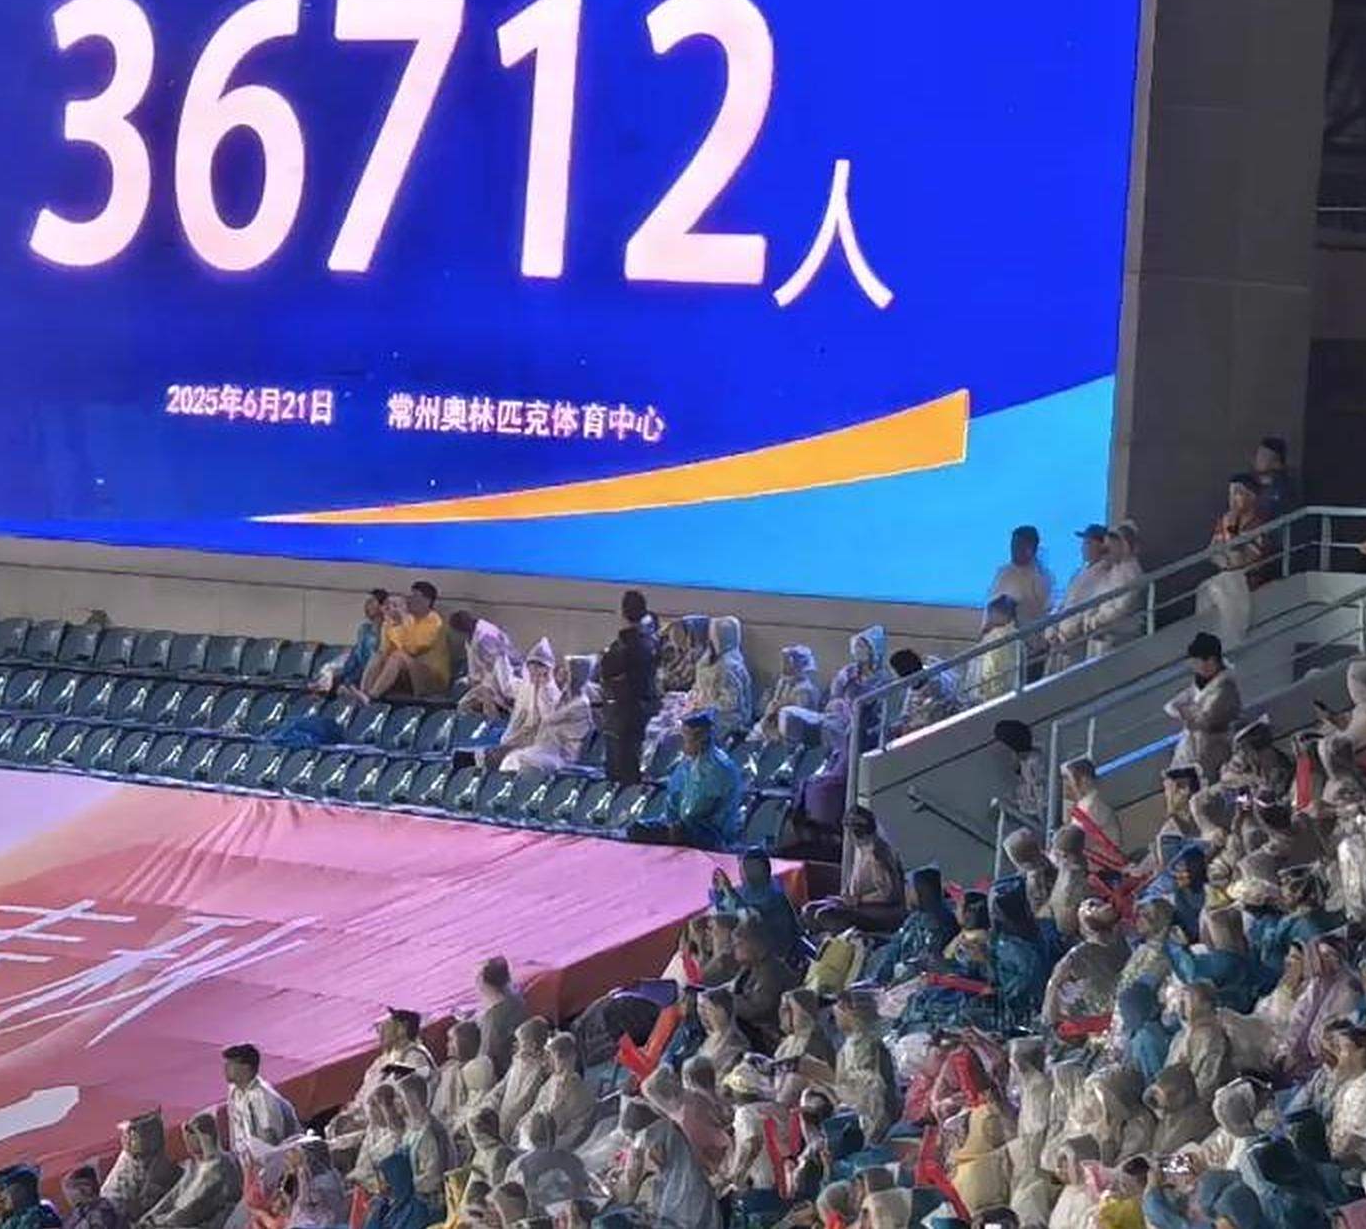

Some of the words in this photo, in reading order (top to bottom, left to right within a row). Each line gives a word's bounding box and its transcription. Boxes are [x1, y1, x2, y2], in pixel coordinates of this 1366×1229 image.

[166, 384, 334, 425] 2025年6月21日
[387, 391, 666, 442] 常州奥林匹克体育中心
